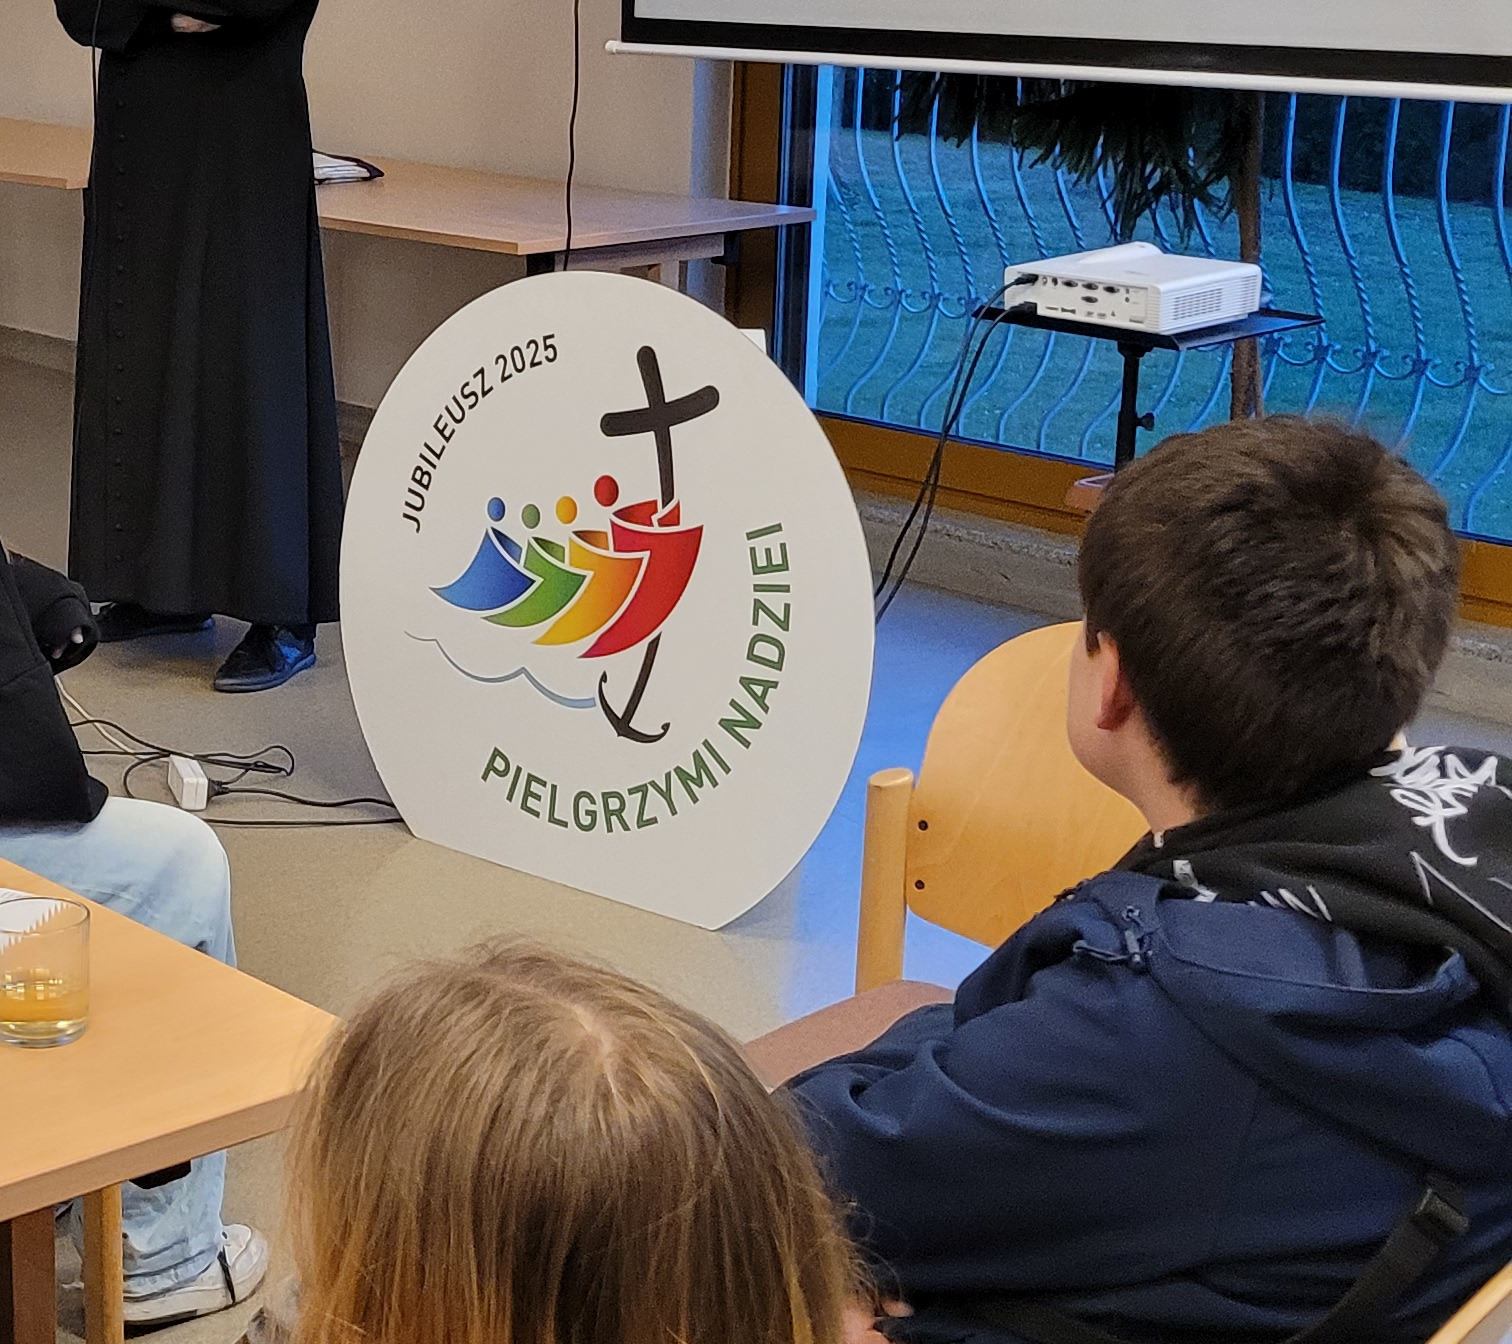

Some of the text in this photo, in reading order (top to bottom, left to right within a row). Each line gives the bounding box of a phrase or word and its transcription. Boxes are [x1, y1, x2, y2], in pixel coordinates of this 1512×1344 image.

[402, 333, 558, 533] JUBILEUSZ 2025
[481, 522, 791, 833] PIELGRZYMI NADZIEI
